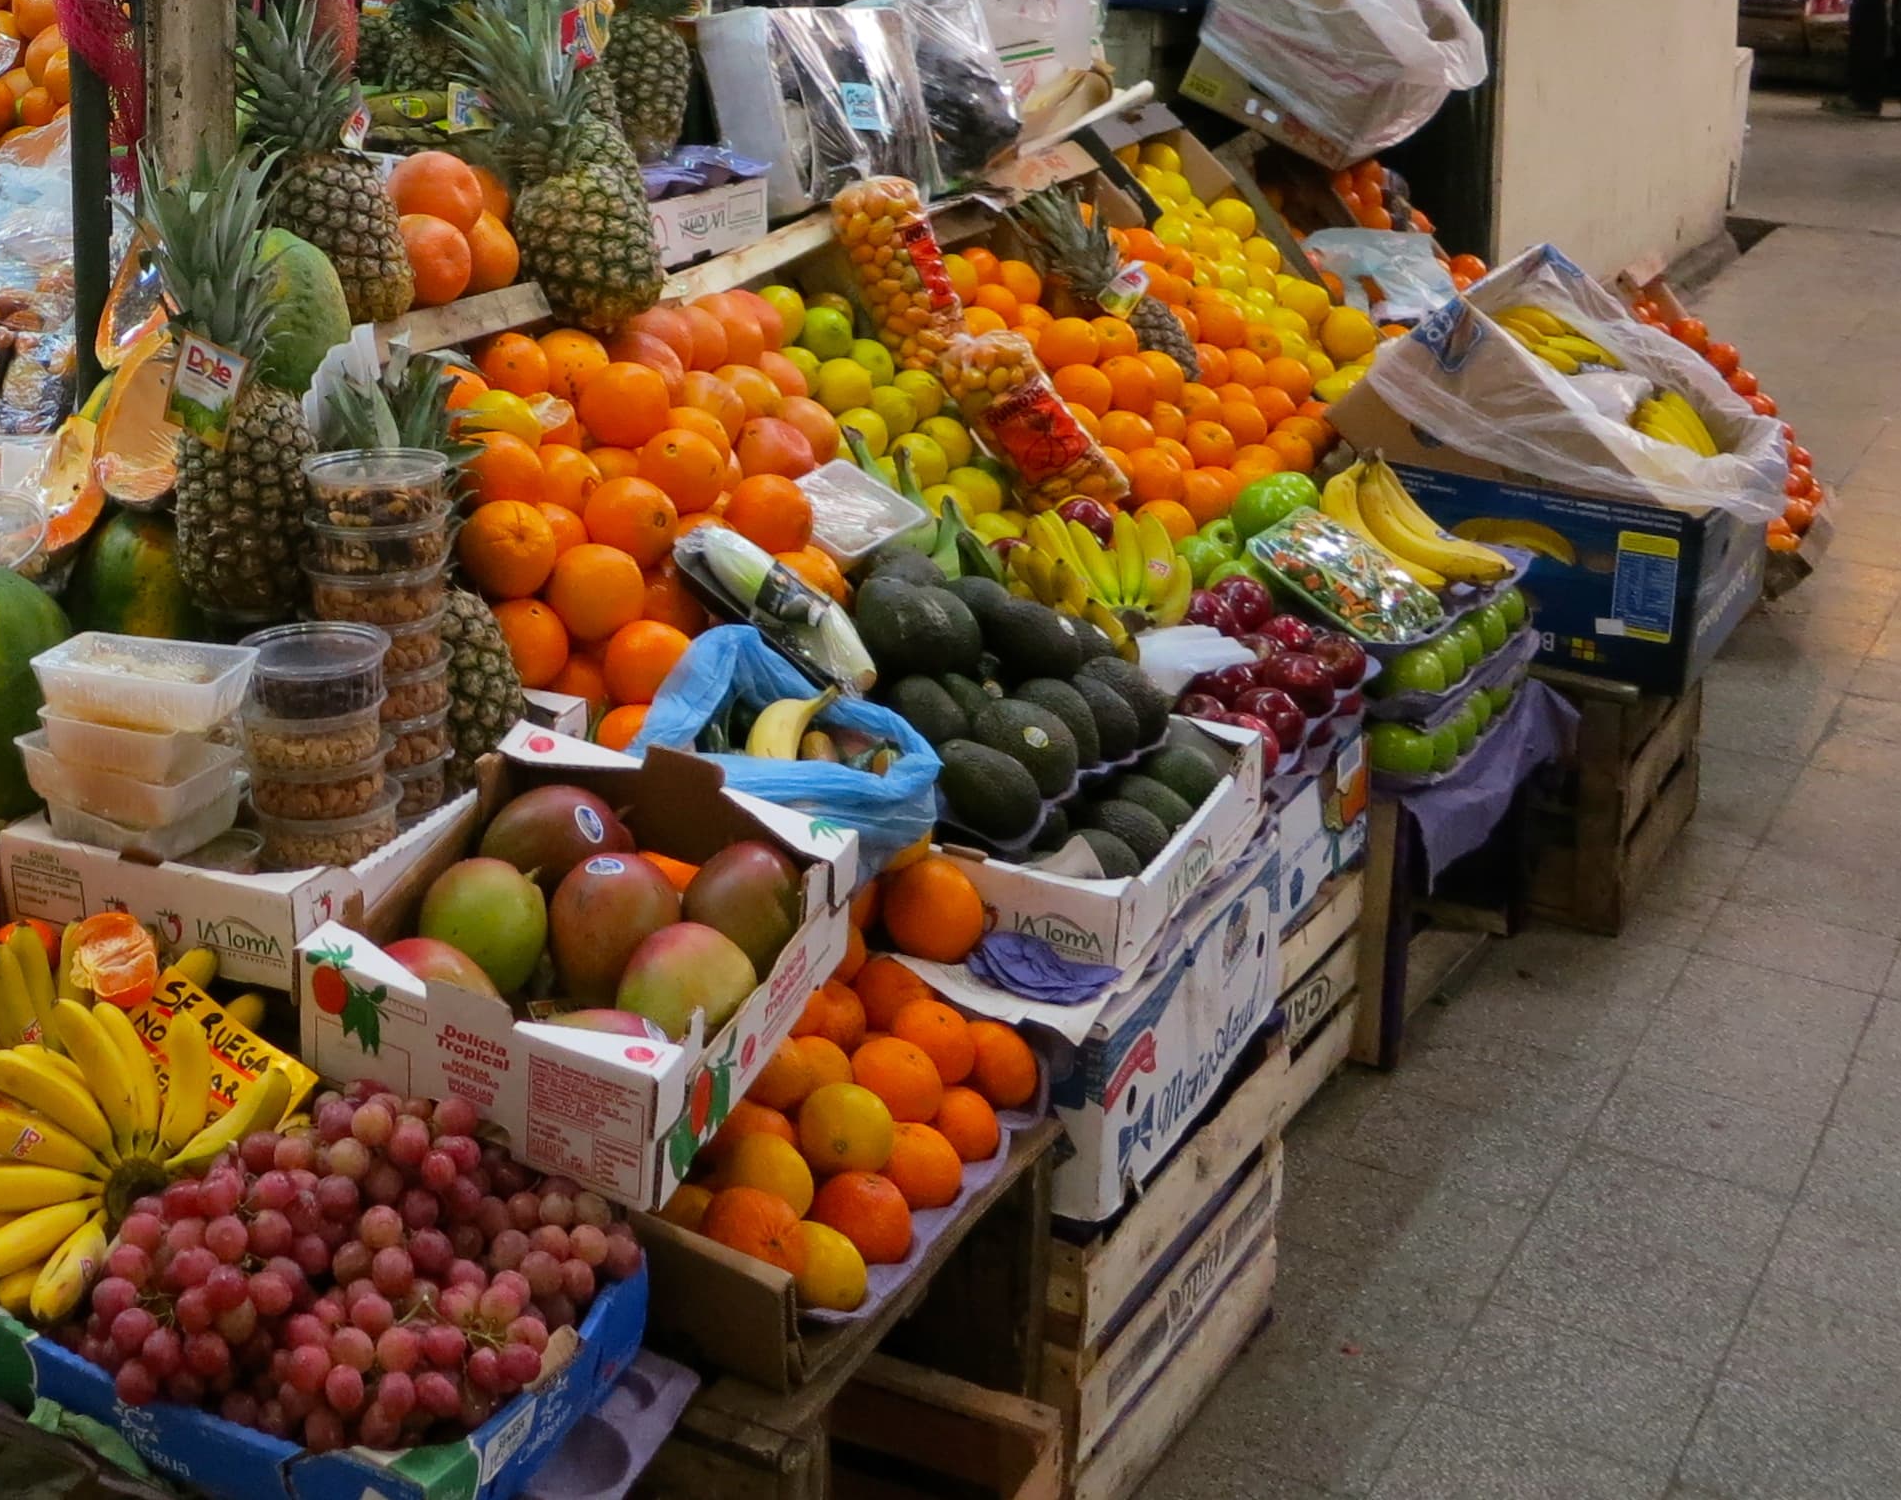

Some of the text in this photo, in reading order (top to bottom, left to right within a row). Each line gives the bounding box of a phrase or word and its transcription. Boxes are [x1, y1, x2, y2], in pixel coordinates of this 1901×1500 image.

[187, 345, 233, 384] Dole
[134, 1009, 168, 1043] NO
[200, 1011, 273, 1077] RUEGA
[435, 1033, 511, 1072] Tropical
